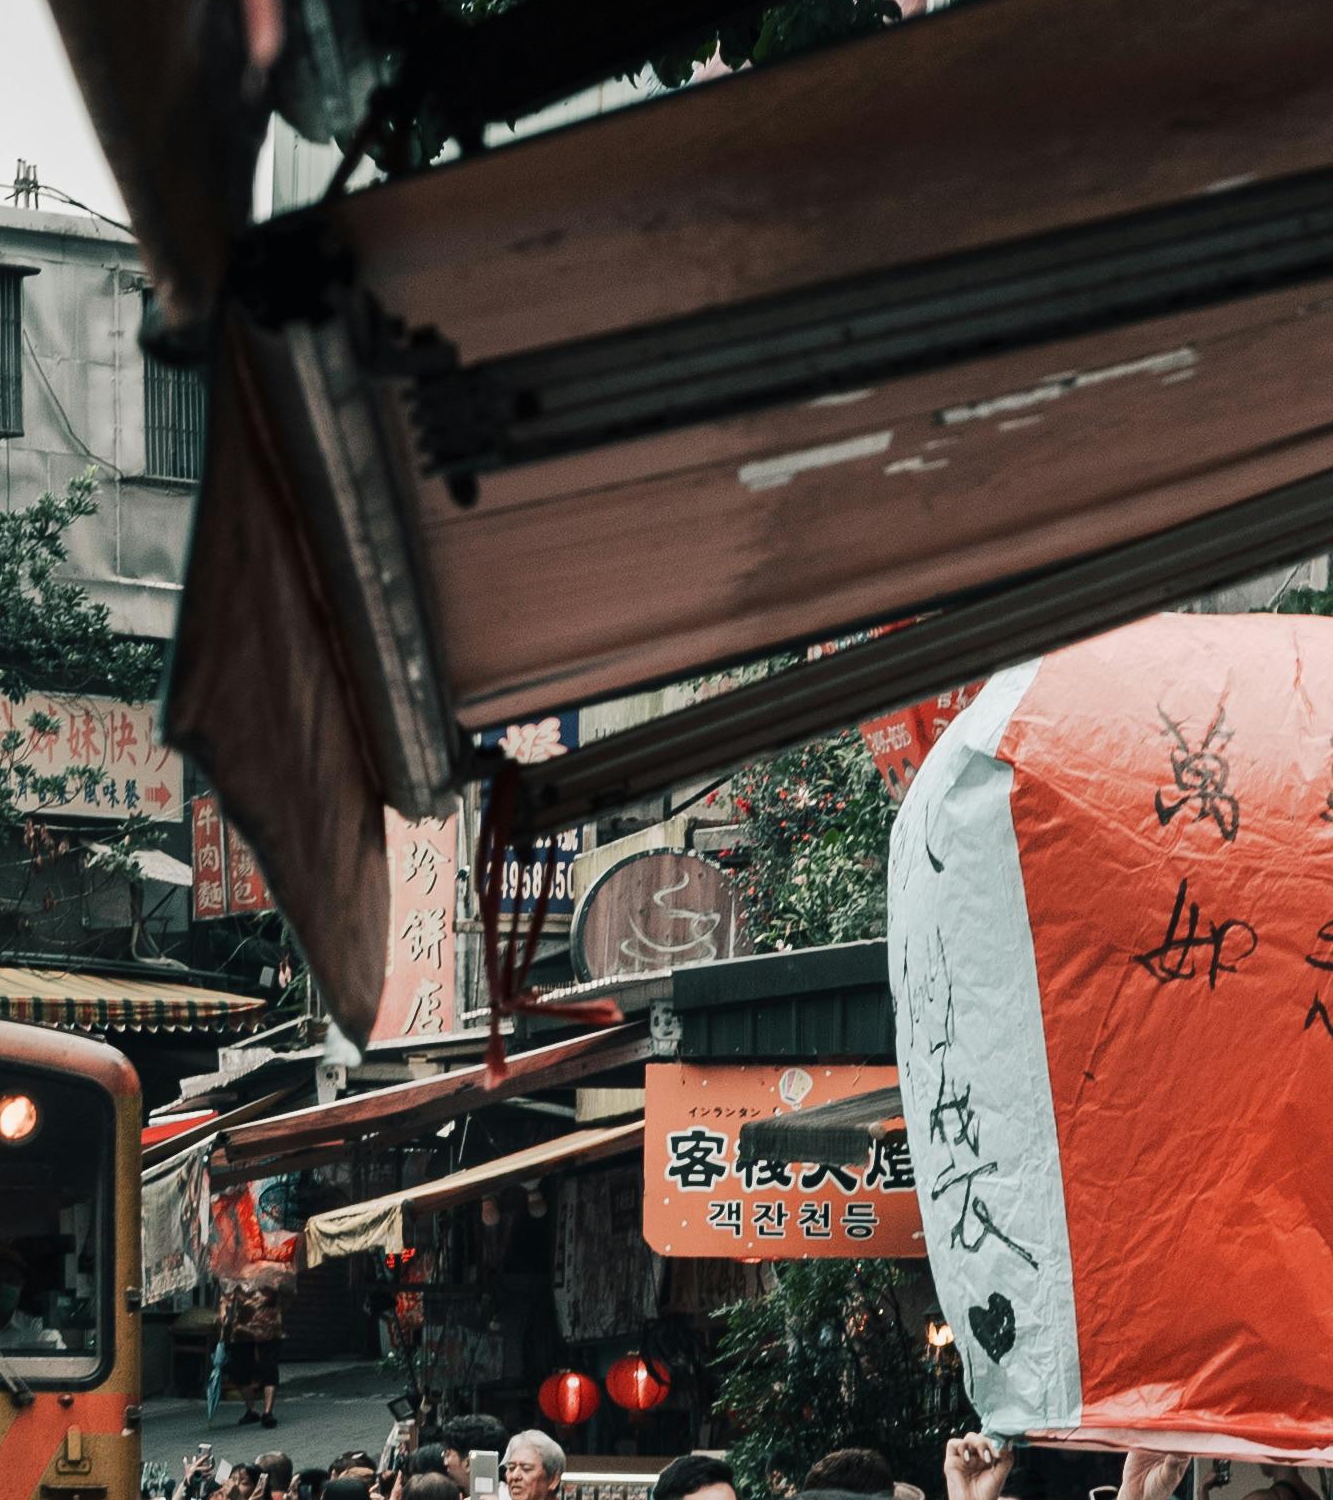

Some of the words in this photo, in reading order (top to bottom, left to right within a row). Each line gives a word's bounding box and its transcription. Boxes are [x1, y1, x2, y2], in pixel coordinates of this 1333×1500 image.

[195, 806, 224, 910] 牛肉麵
[707, 1200, 879, 1240] 객잔천등
